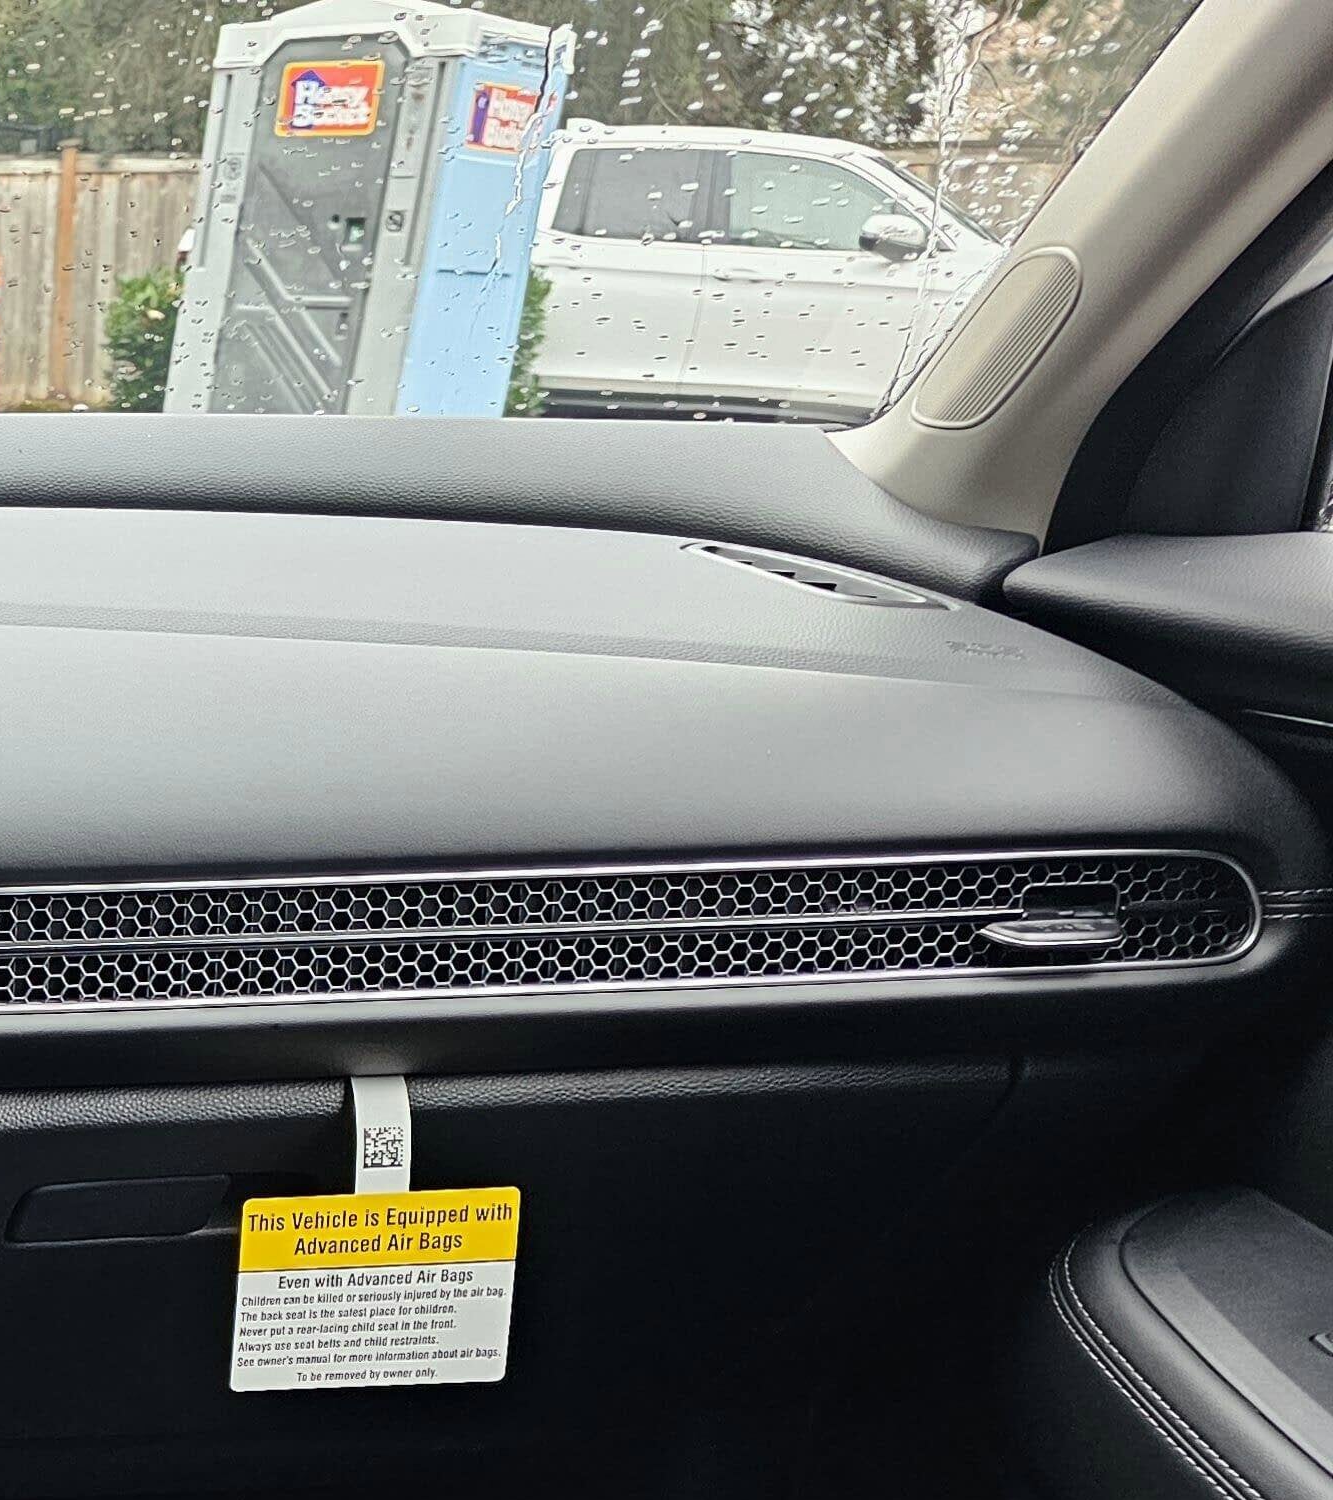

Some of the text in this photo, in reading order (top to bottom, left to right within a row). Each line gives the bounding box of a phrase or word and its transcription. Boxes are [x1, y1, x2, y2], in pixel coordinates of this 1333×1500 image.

[248, 1203, 512, 1232] This Vehicle is Equipped with
[294, 1232, 463, 1255] Advanced Air Bags
[278, 1269, 473, 1289] Even with Advanced Air Bags
[241, 1287, 507, 1307] Children can be killed or seriously injured by the air bag.
[241, 1304, 457, 1322] The back seat is the safest place for children.
[239, 1327, 267, 1337] Never
[270, 1327, 285, 1338] put
[296, 1323, 349, 1335] rear-facing
[351, 1322, 375, 1332] child
[378, 1321, 398, 1331] seat
[401, 1320, 410, 1330] in
[413, 1320, 428, 1329] the
[430, 1319, 457, 1329] front.
[238, 1335, 439, 1353] Always use seat belts and child restraints.
[237, 1347, 501, 1367] See owner's manual for more information about air bags.
[297, 1368, 438, 1382] To be removed by owner only.
